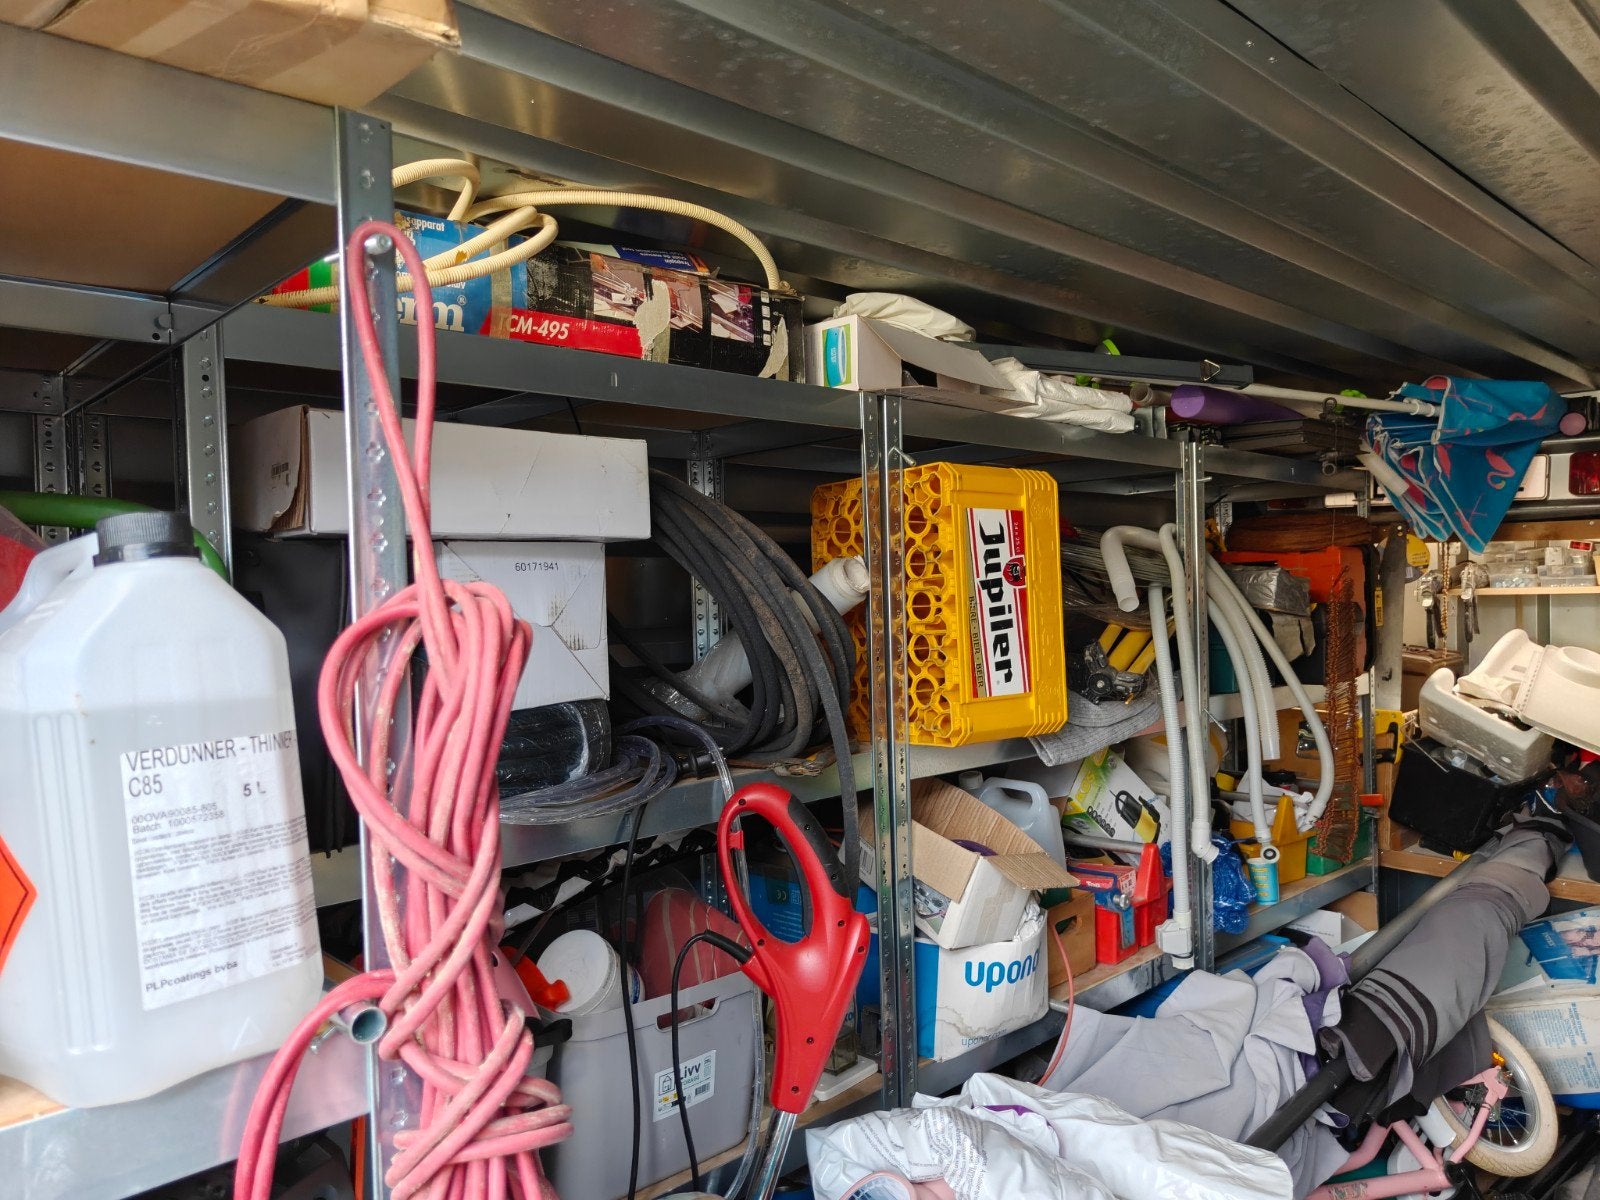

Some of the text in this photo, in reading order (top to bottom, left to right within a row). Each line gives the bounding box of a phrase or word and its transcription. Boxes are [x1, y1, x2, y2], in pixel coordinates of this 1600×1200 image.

[514, 562, 559, 571] 60171941
[978, 520, 1014, 683] Jupiler
[975, 663, 984, 688] BEER
[125, 739, 237, 772] VERDUNNER
[128, 773, 164, 798] C85
[243, 780, 267, 797] 5 L
[214, 960, 239, 975] bvba
[964, 948, 1040, 993] upono
[680, 1063, 701, 1080] ivv
